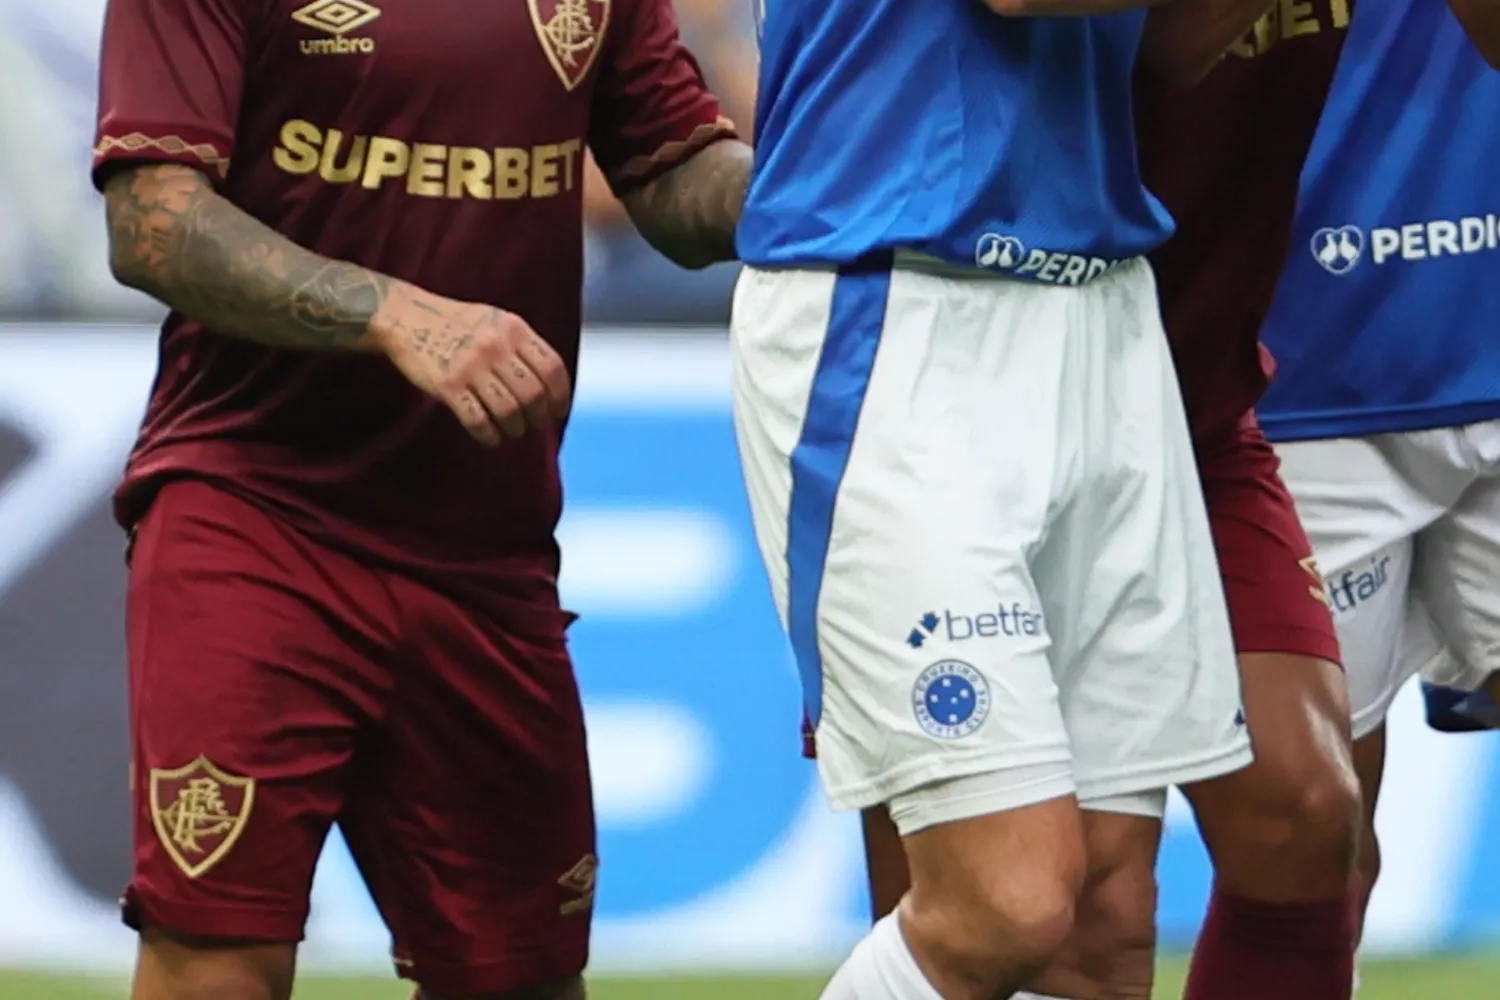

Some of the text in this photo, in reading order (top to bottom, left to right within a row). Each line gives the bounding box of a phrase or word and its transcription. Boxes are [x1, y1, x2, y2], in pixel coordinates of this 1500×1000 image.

[299, 36, 374, 55] umbro
[272, 118, 581, 200] SUPERBET
[1328, 554, 1391, 613] tfair
[944, 602, 1042, 641] betfar
